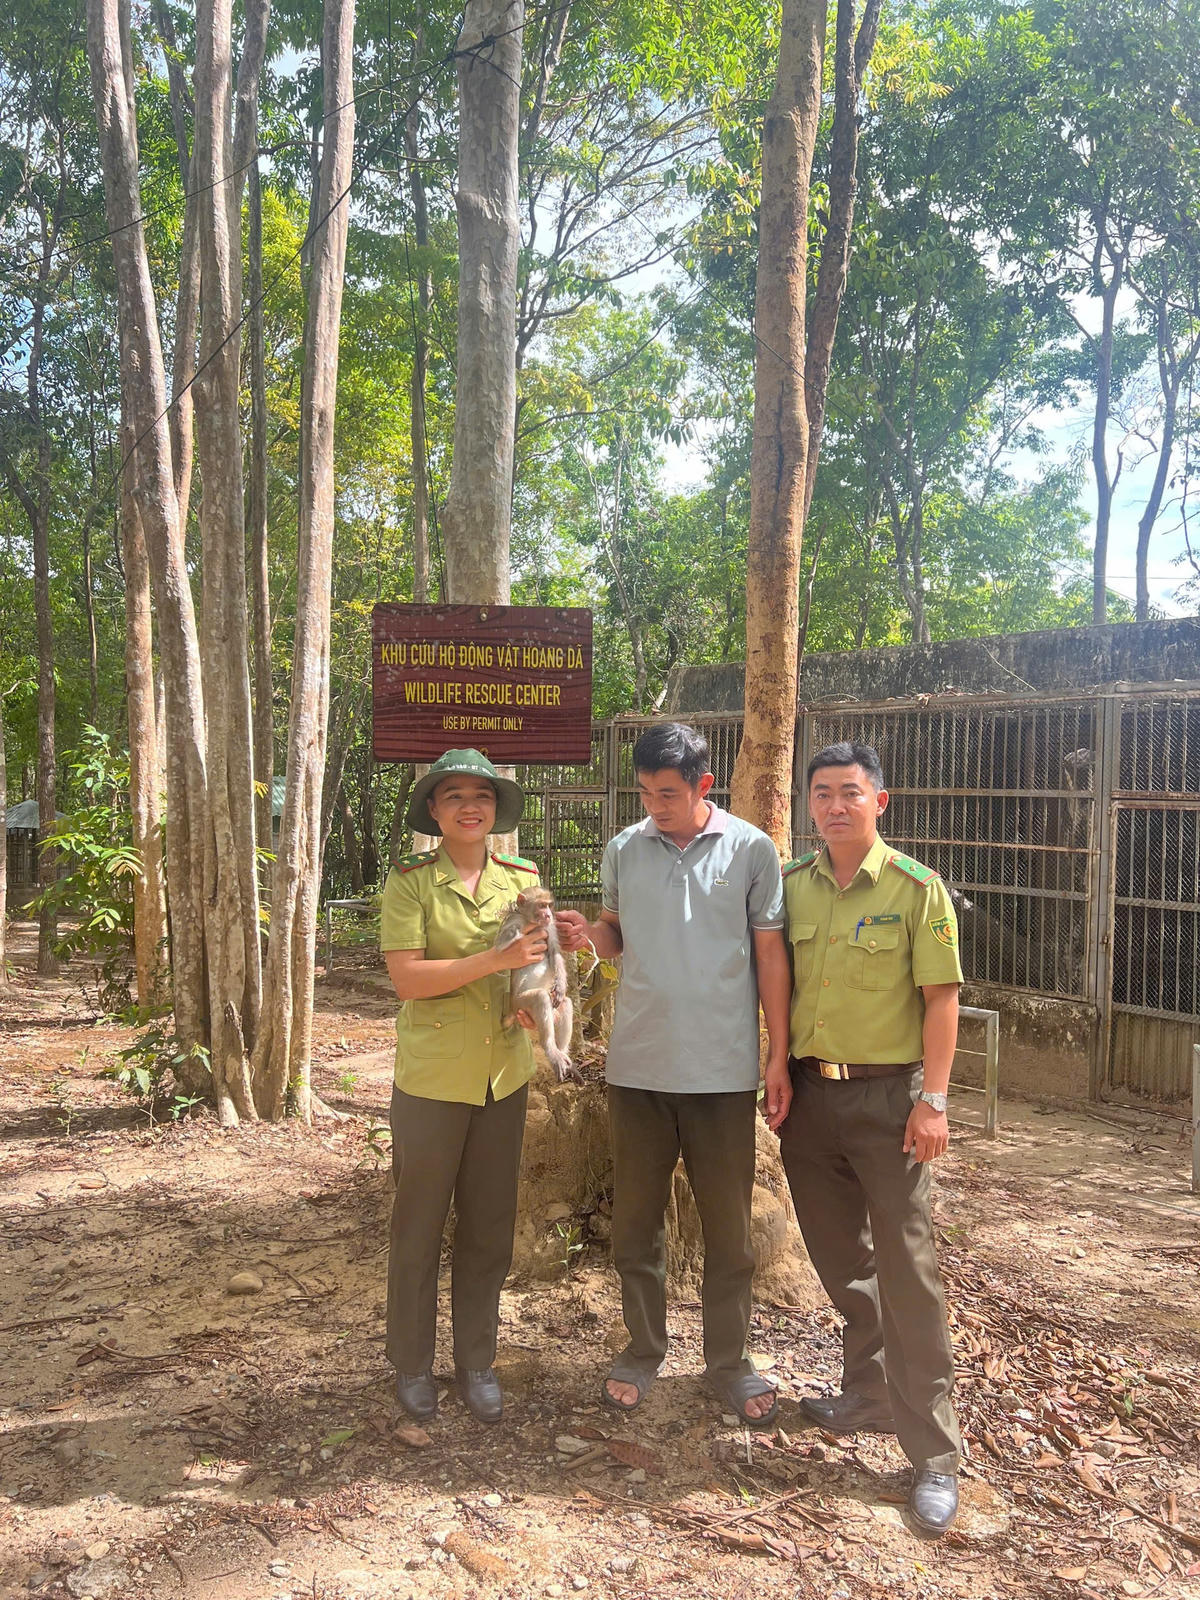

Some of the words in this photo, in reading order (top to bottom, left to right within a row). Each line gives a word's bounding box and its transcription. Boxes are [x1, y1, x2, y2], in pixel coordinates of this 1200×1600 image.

[381, 643, 407, 665] KHU
[410, 639, 435, 666] CỨU
[440, 640, 456, 670] HỘ
[458, 641, 493, 670] ĐỘNG
[497, 642, 520, 671] VẬT
[523, 647, 564, 669] HOANG
[567, 643, 584, 669] DÃ
[404, 682, 462, 704] WILDLIFE
[465, 683, 512, 705] RESCUE
[516, 684, 561, 706] CENTER
[443, 716, 458, 730] USE
[460, 716, 471, 730] BY
[472, 716, 501, 730] PERMIT
[503, 717, 523, 731] ONLY
